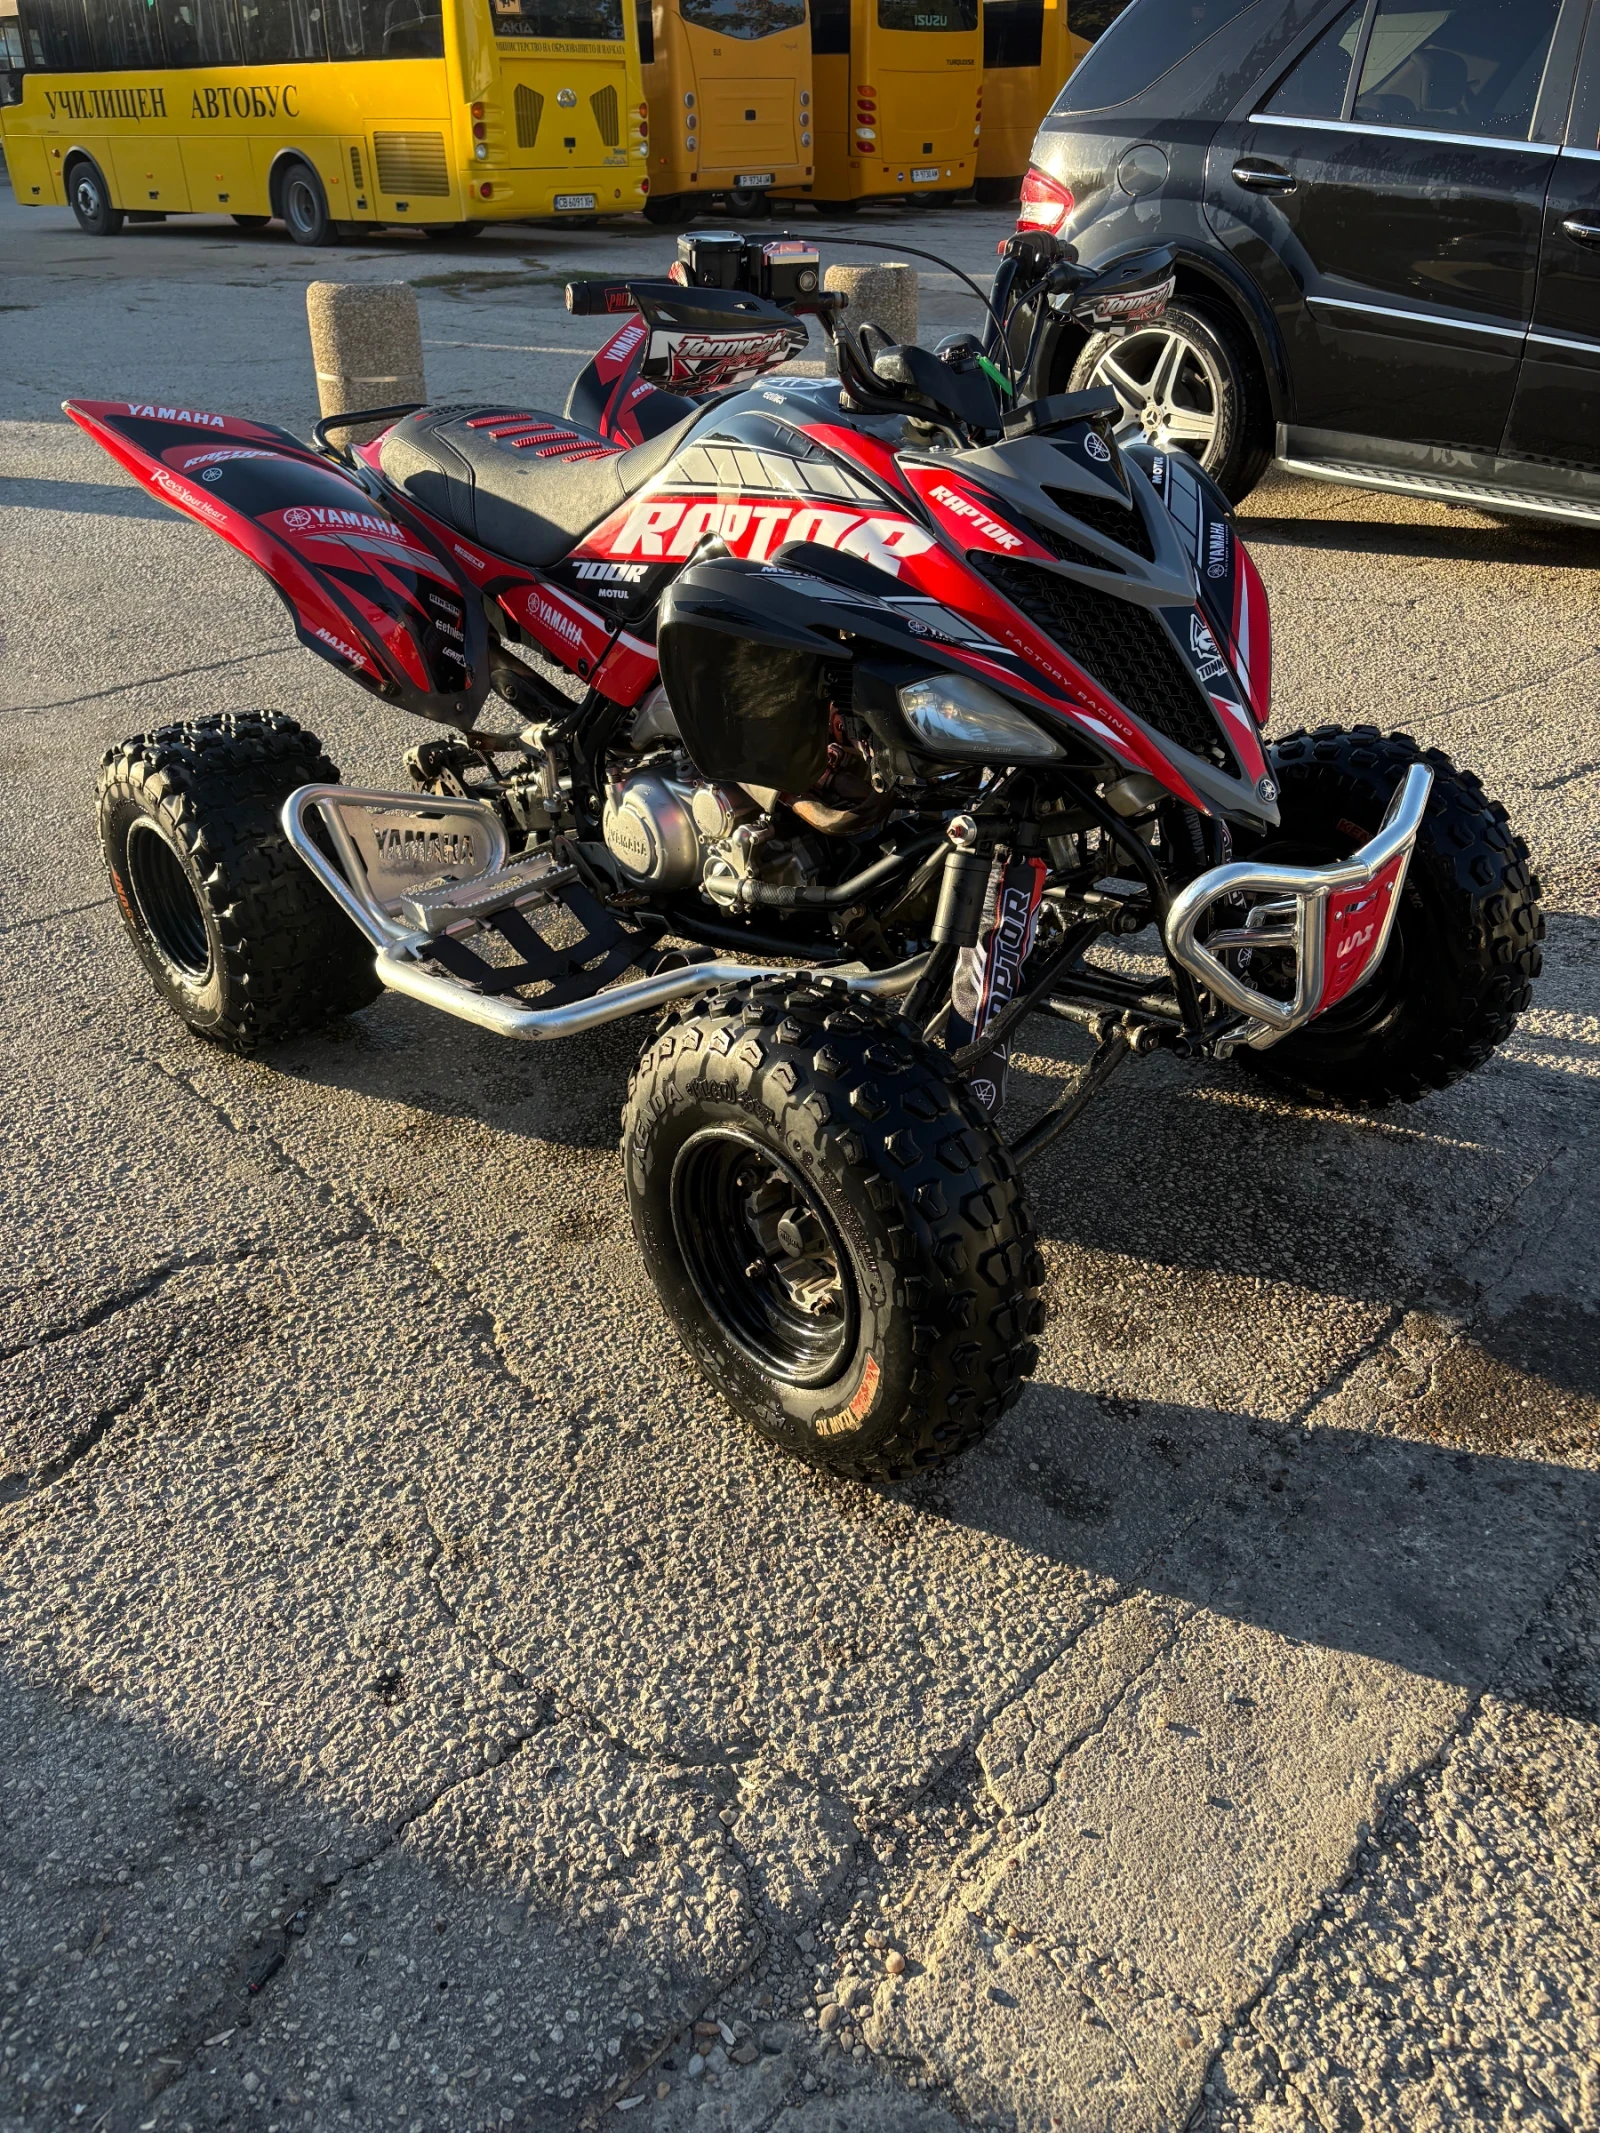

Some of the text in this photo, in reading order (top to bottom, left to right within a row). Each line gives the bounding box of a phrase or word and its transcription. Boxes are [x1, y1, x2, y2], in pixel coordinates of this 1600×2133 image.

[914, 15, 947, 26] ISUZU
[44, 85, 300, 124] УЧИЛИЩЕН АВТОБУС
[604, 326, 646, 362] YAMAHA
[127, 403, 225, 428] YAMAHA
[1152, 456, 1164, 485] MOTUL
[202, 502, 228, 522] Heart
[290, 524, 352, 533] FACTORY
[310, 508, 405, 539] YAMAHA
[928, 485, 1023, 551] RAPTOR
[608, 502, 938, 578] RAPTOR
[1209, 522, 1225, 565] YAMAHA
[572, 561, 649, 583] 700R
[598, 588, 629, 599] MOTUL
[540, 600, 583, 646] YAMAHA
[315, 627, 367, 666] MAXXIS
[1005, 629, 1134, 737] FACTORY RACING
[374, 827, 475, 866] YAMAHA
[632, 1080, 684, 1170] KENDA
